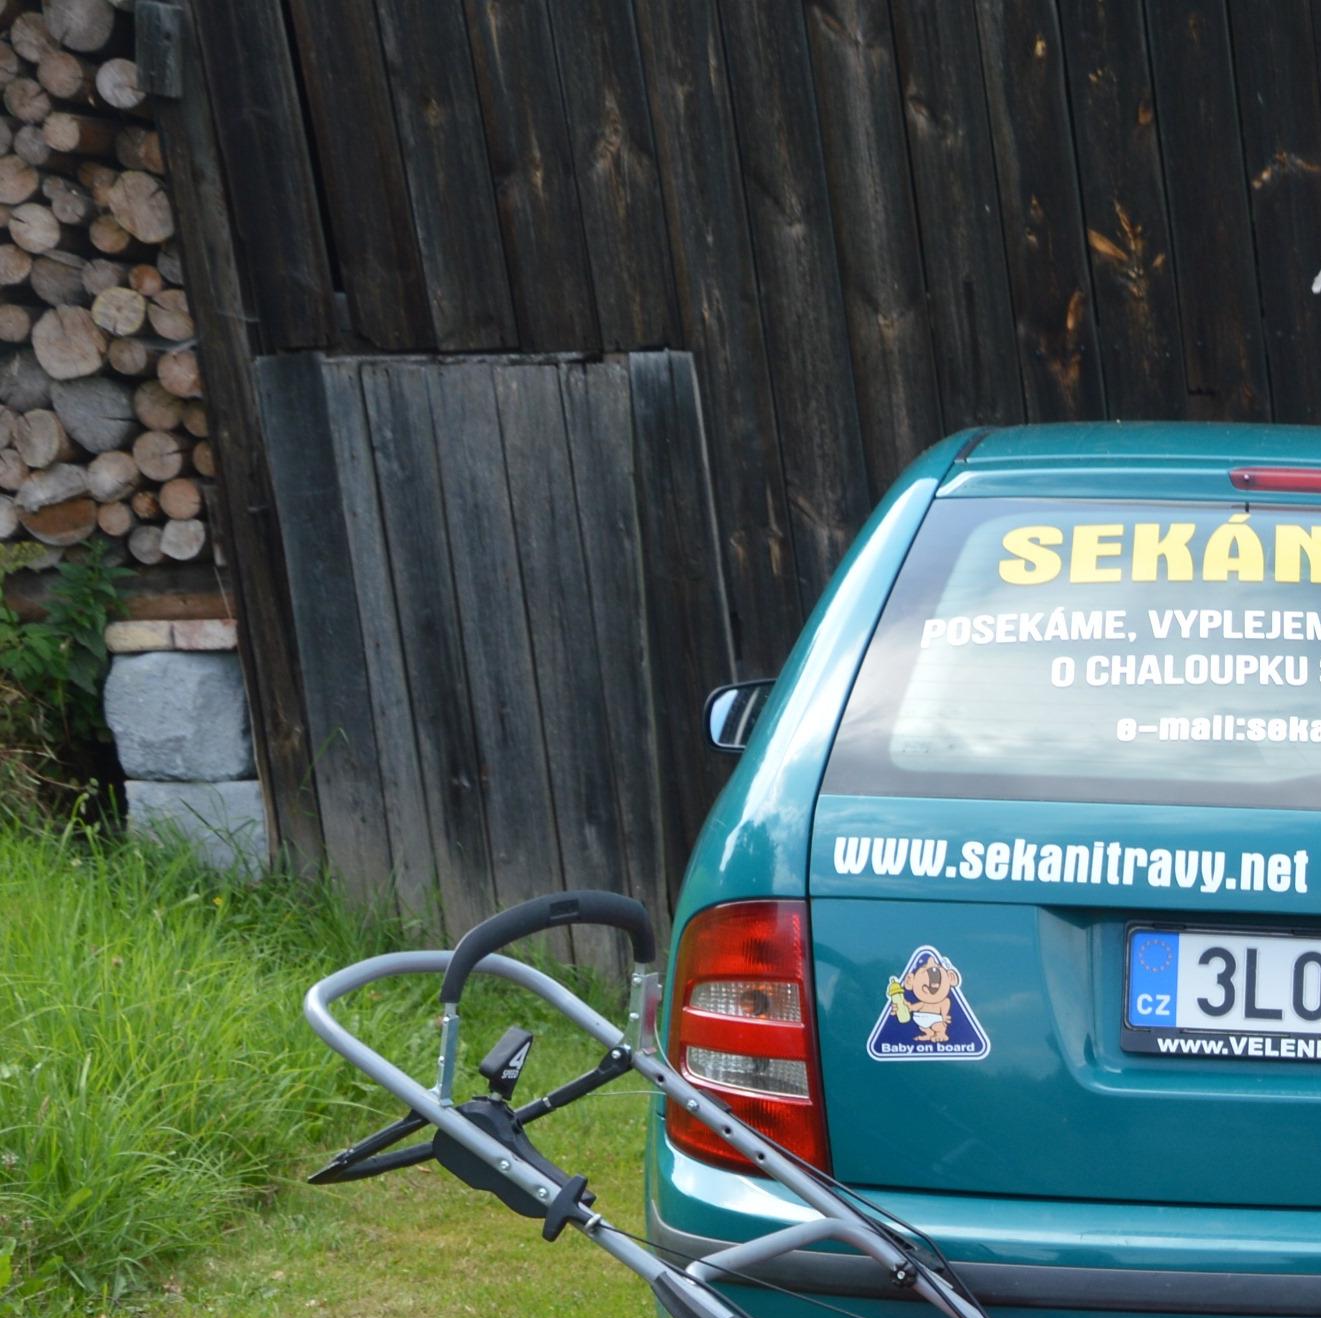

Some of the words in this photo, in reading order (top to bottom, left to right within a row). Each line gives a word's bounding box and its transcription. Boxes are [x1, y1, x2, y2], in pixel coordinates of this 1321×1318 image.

[920, 606, 1137, 649] POSEKÁME,
[1051, 656, 1075, 688] O
[1086, 654, 1308, 687] CHALOUPKU
[833, 835, 1309, 895] www.sekanitravy.net
[1136, 993, 1171, 1016] CZ
[509, 1041, 531, 1070] 4
[880, 1042, 914, 1055] Baby
[916, 1044, 934, 1053] on
[936, 1042, 976, 1053] board
